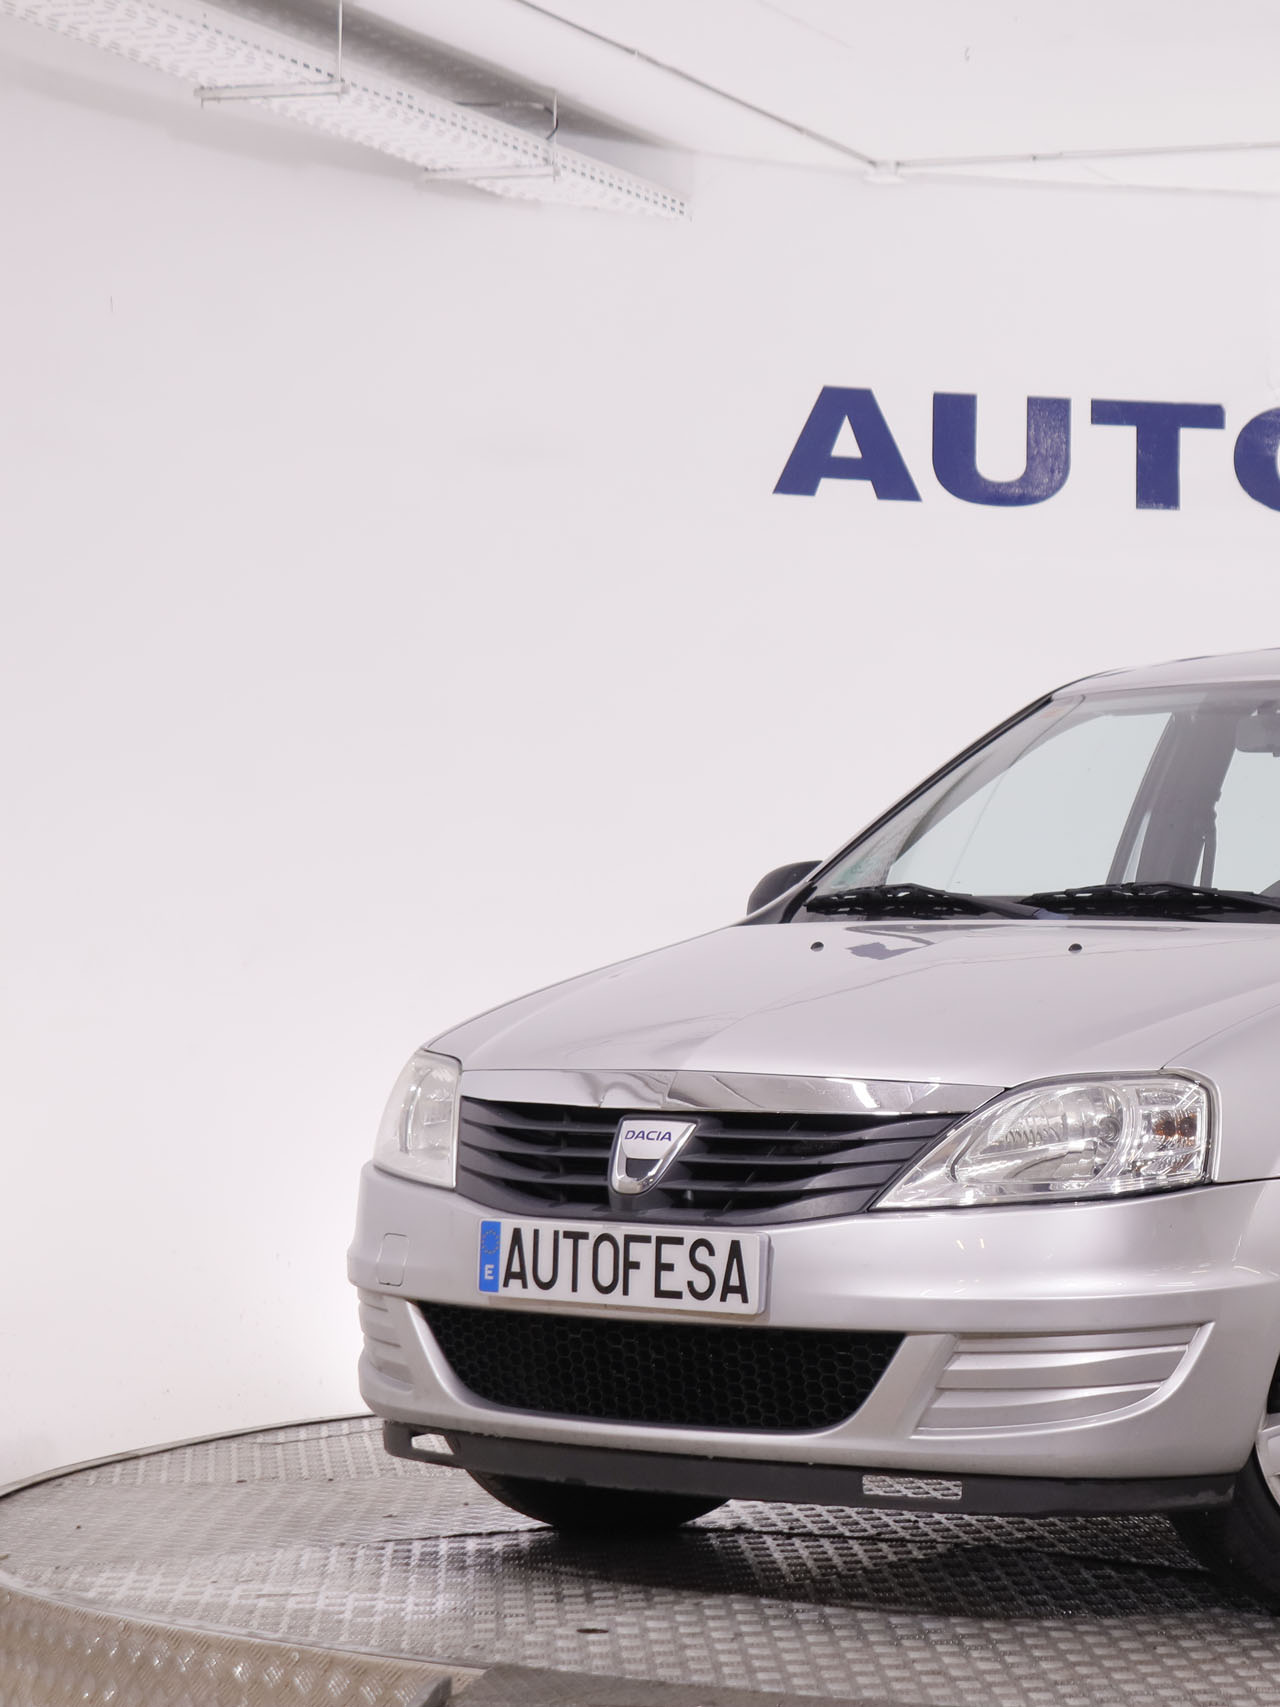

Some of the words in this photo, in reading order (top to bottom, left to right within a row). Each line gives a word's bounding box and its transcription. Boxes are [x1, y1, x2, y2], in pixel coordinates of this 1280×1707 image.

[624, 1129, 672, 1142] DACIA
[485, 1264, 494, 1280] E
[503, 1227, 749, 1304] AUTOFESA
